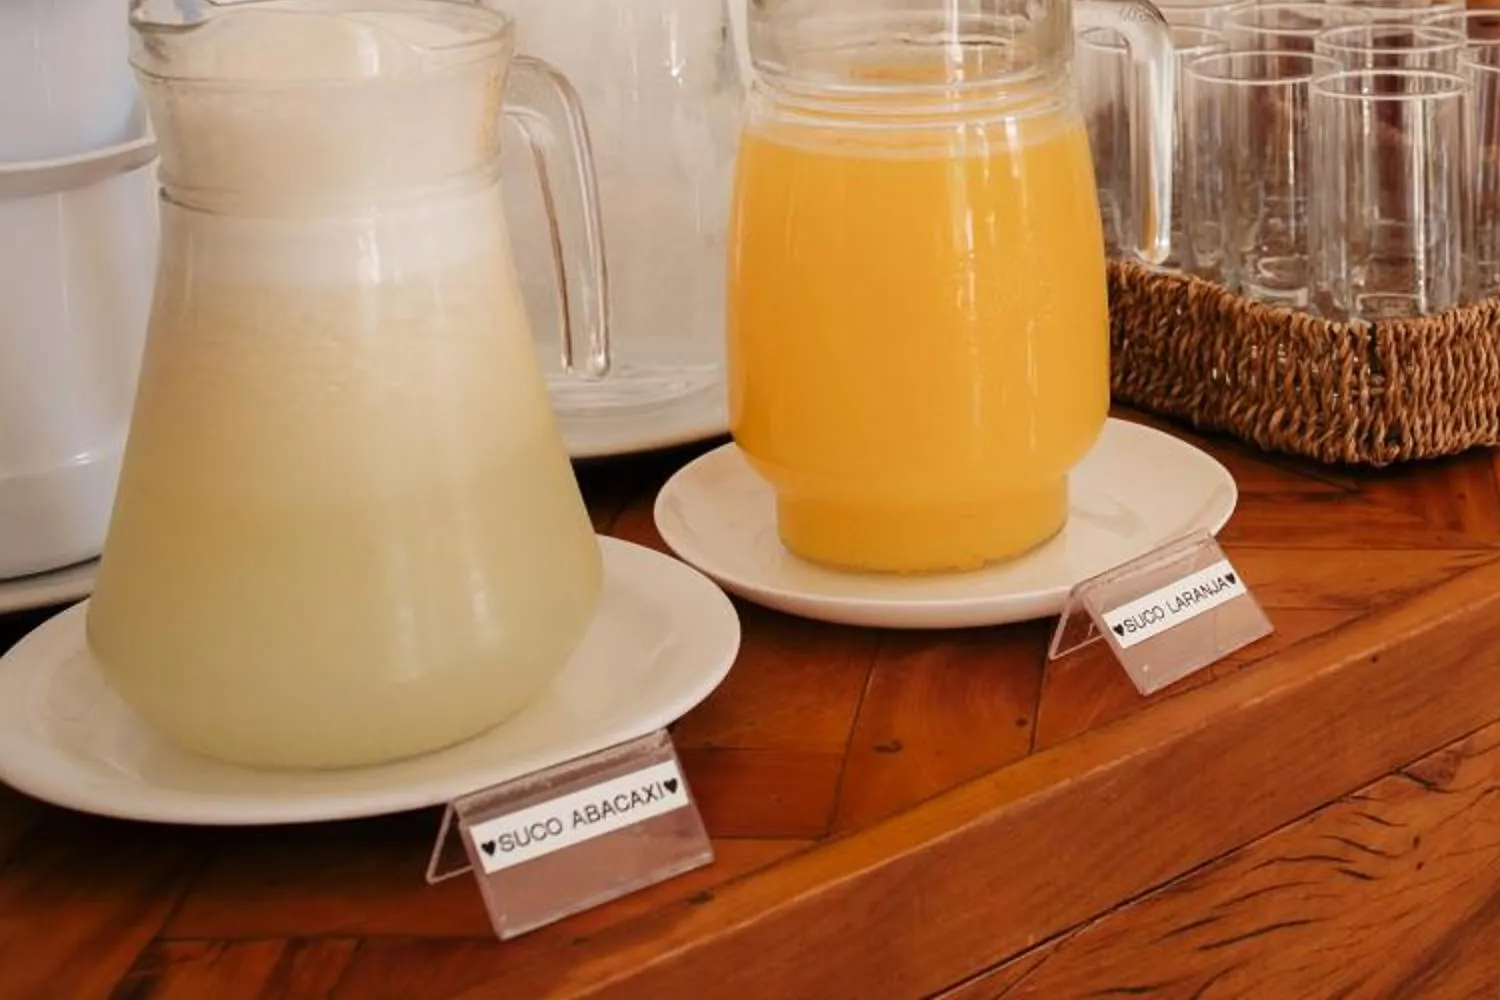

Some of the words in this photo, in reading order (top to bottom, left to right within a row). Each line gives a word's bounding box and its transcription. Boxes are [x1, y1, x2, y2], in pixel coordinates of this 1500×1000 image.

[1123, 605, 1165, 634] SUCO
[1166, 577, 1229, 614] LARANJA
[497, 817, 563, 853] SUCO
[571, 781, 665, 829] ABACAXI
